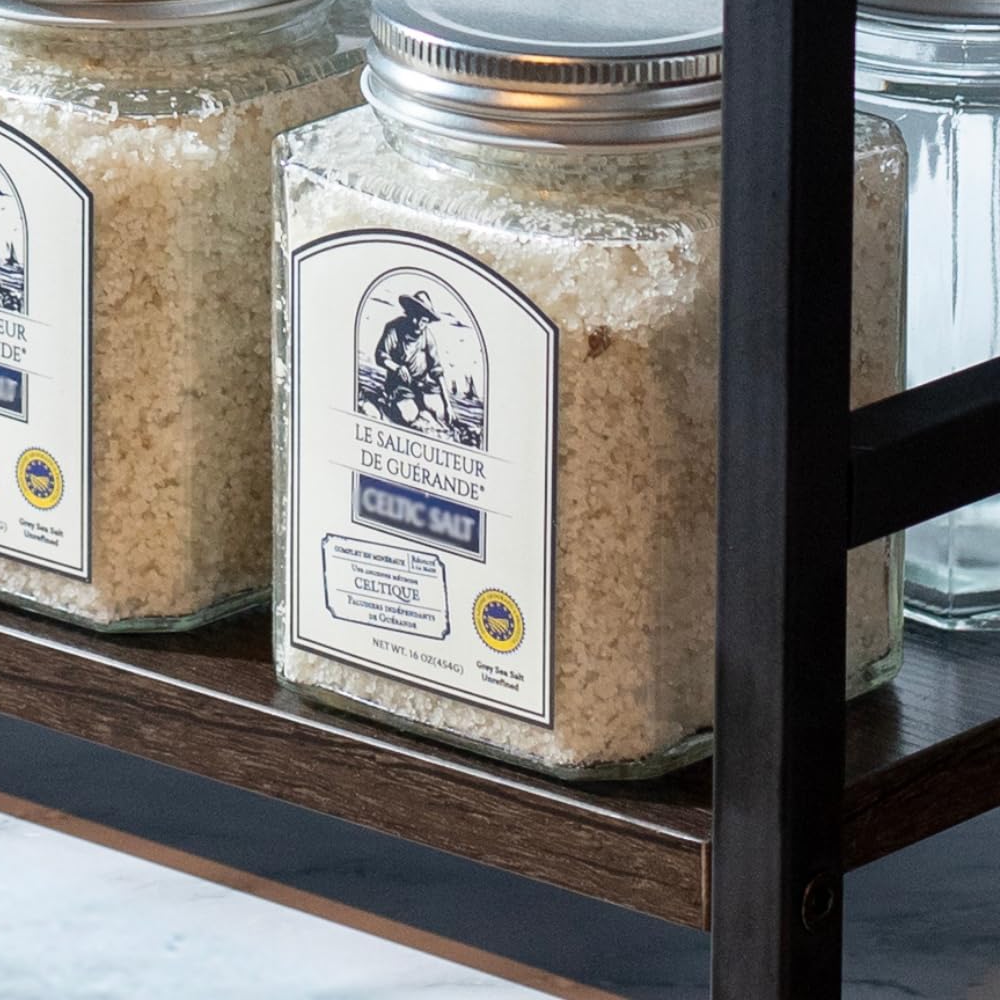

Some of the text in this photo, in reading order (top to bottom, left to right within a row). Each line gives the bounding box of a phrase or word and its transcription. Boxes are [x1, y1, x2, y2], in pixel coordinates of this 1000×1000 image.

[355, 423, 487, 480] LE SALICULTEUR
[361, 449, 383, 471] DE
[361, 486, 475, 543] CELTIC SALT
[19, 516, 65, 538] Grey Sea Salt
[24, 530, 60, 548] Unrefined
[353, 576, 421, 603] CELTIQUE
[372, 637, 391, 651] NET
[391, 642, 407, 656] WT.
[409, 649, 420, 661] 16
[476, 660, 524, 682] Grey Sea Salt
[481, 673, 520, 693] Unrefined
